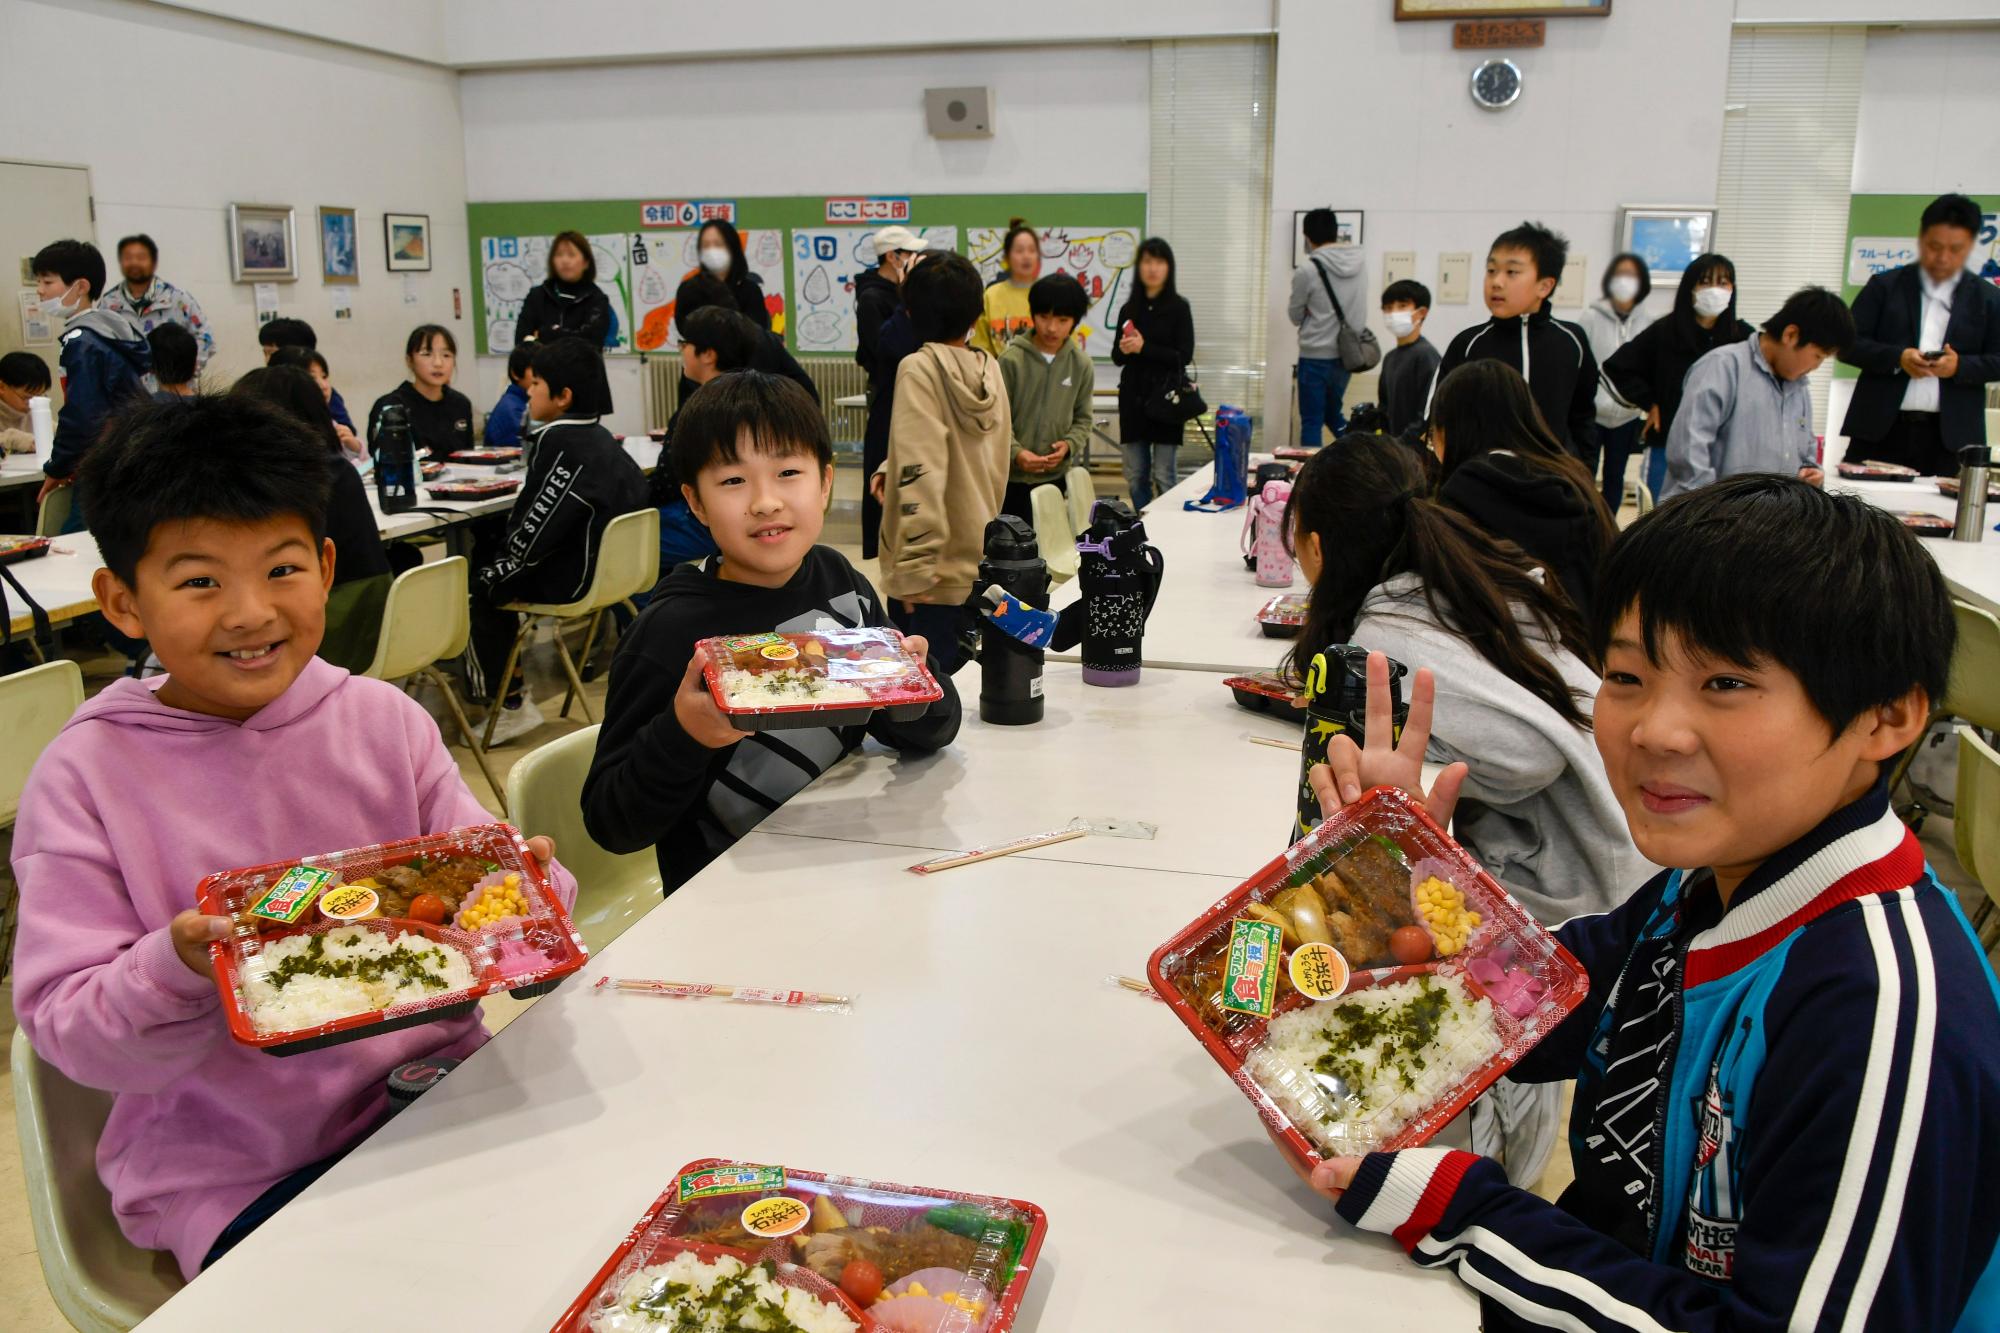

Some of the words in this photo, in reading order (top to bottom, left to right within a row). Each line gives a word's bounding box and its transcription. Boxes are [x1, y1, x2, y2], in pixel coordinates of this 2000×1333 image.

[645, 204, 732, 221] 令和6年度
[829, 202, 907, 218] にこにこ団
[524, 466, 571, 533] STRIPES
[328, 890, 372, 915] 石浜牛
[1232, 926, 1268, 1003] 食育授業
[1311, 945, 1334, 997] 石浜牛
[748, 1204, 804, 1230] 石浜牛
[751, 1201, 789, 1218] ひがしうら
